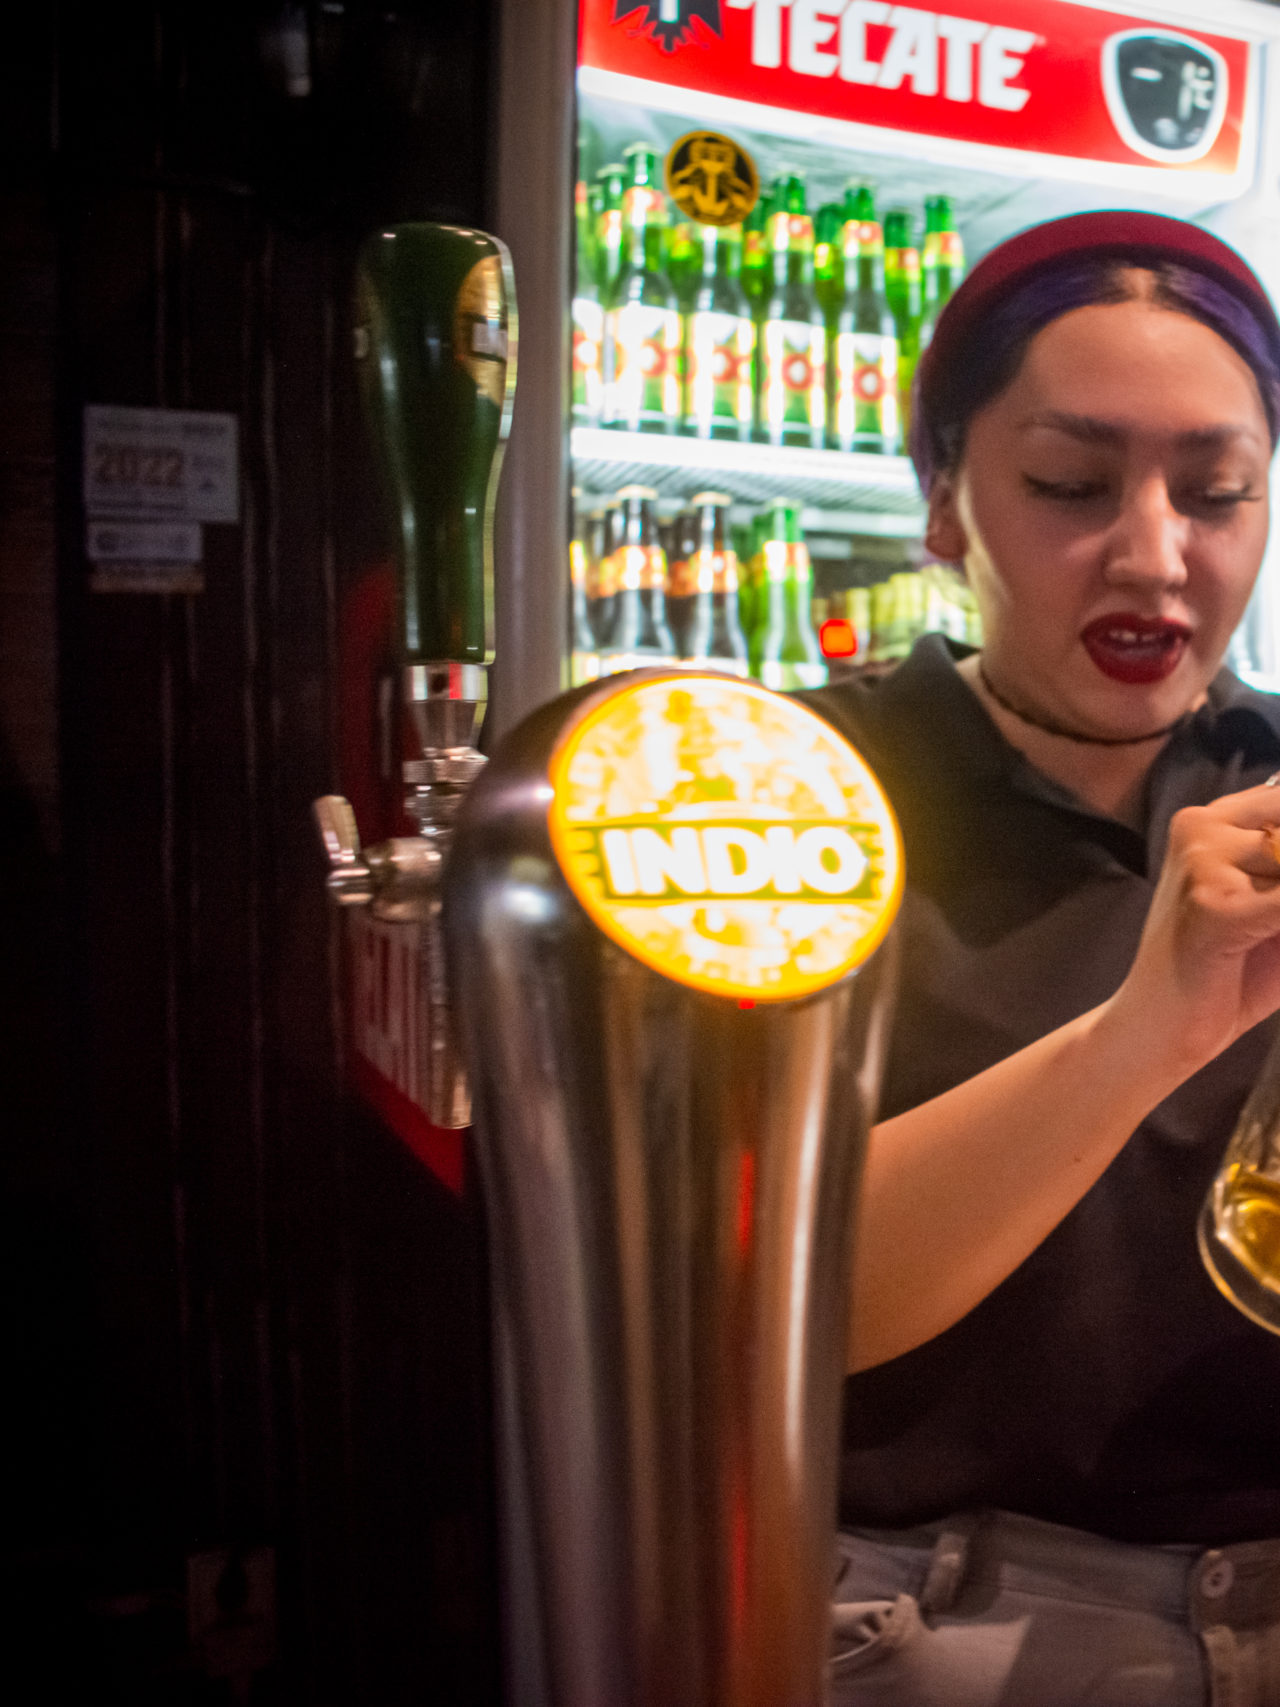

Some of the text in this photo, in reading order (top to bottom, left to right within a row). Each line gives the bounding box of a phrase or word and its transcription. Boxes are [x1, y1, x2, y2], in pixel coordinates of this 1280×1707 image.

[725, 0, 1031, 112] TECATE
[95, 446, 185, 486] 2022
[602, 826, 869, 896] INDIO
